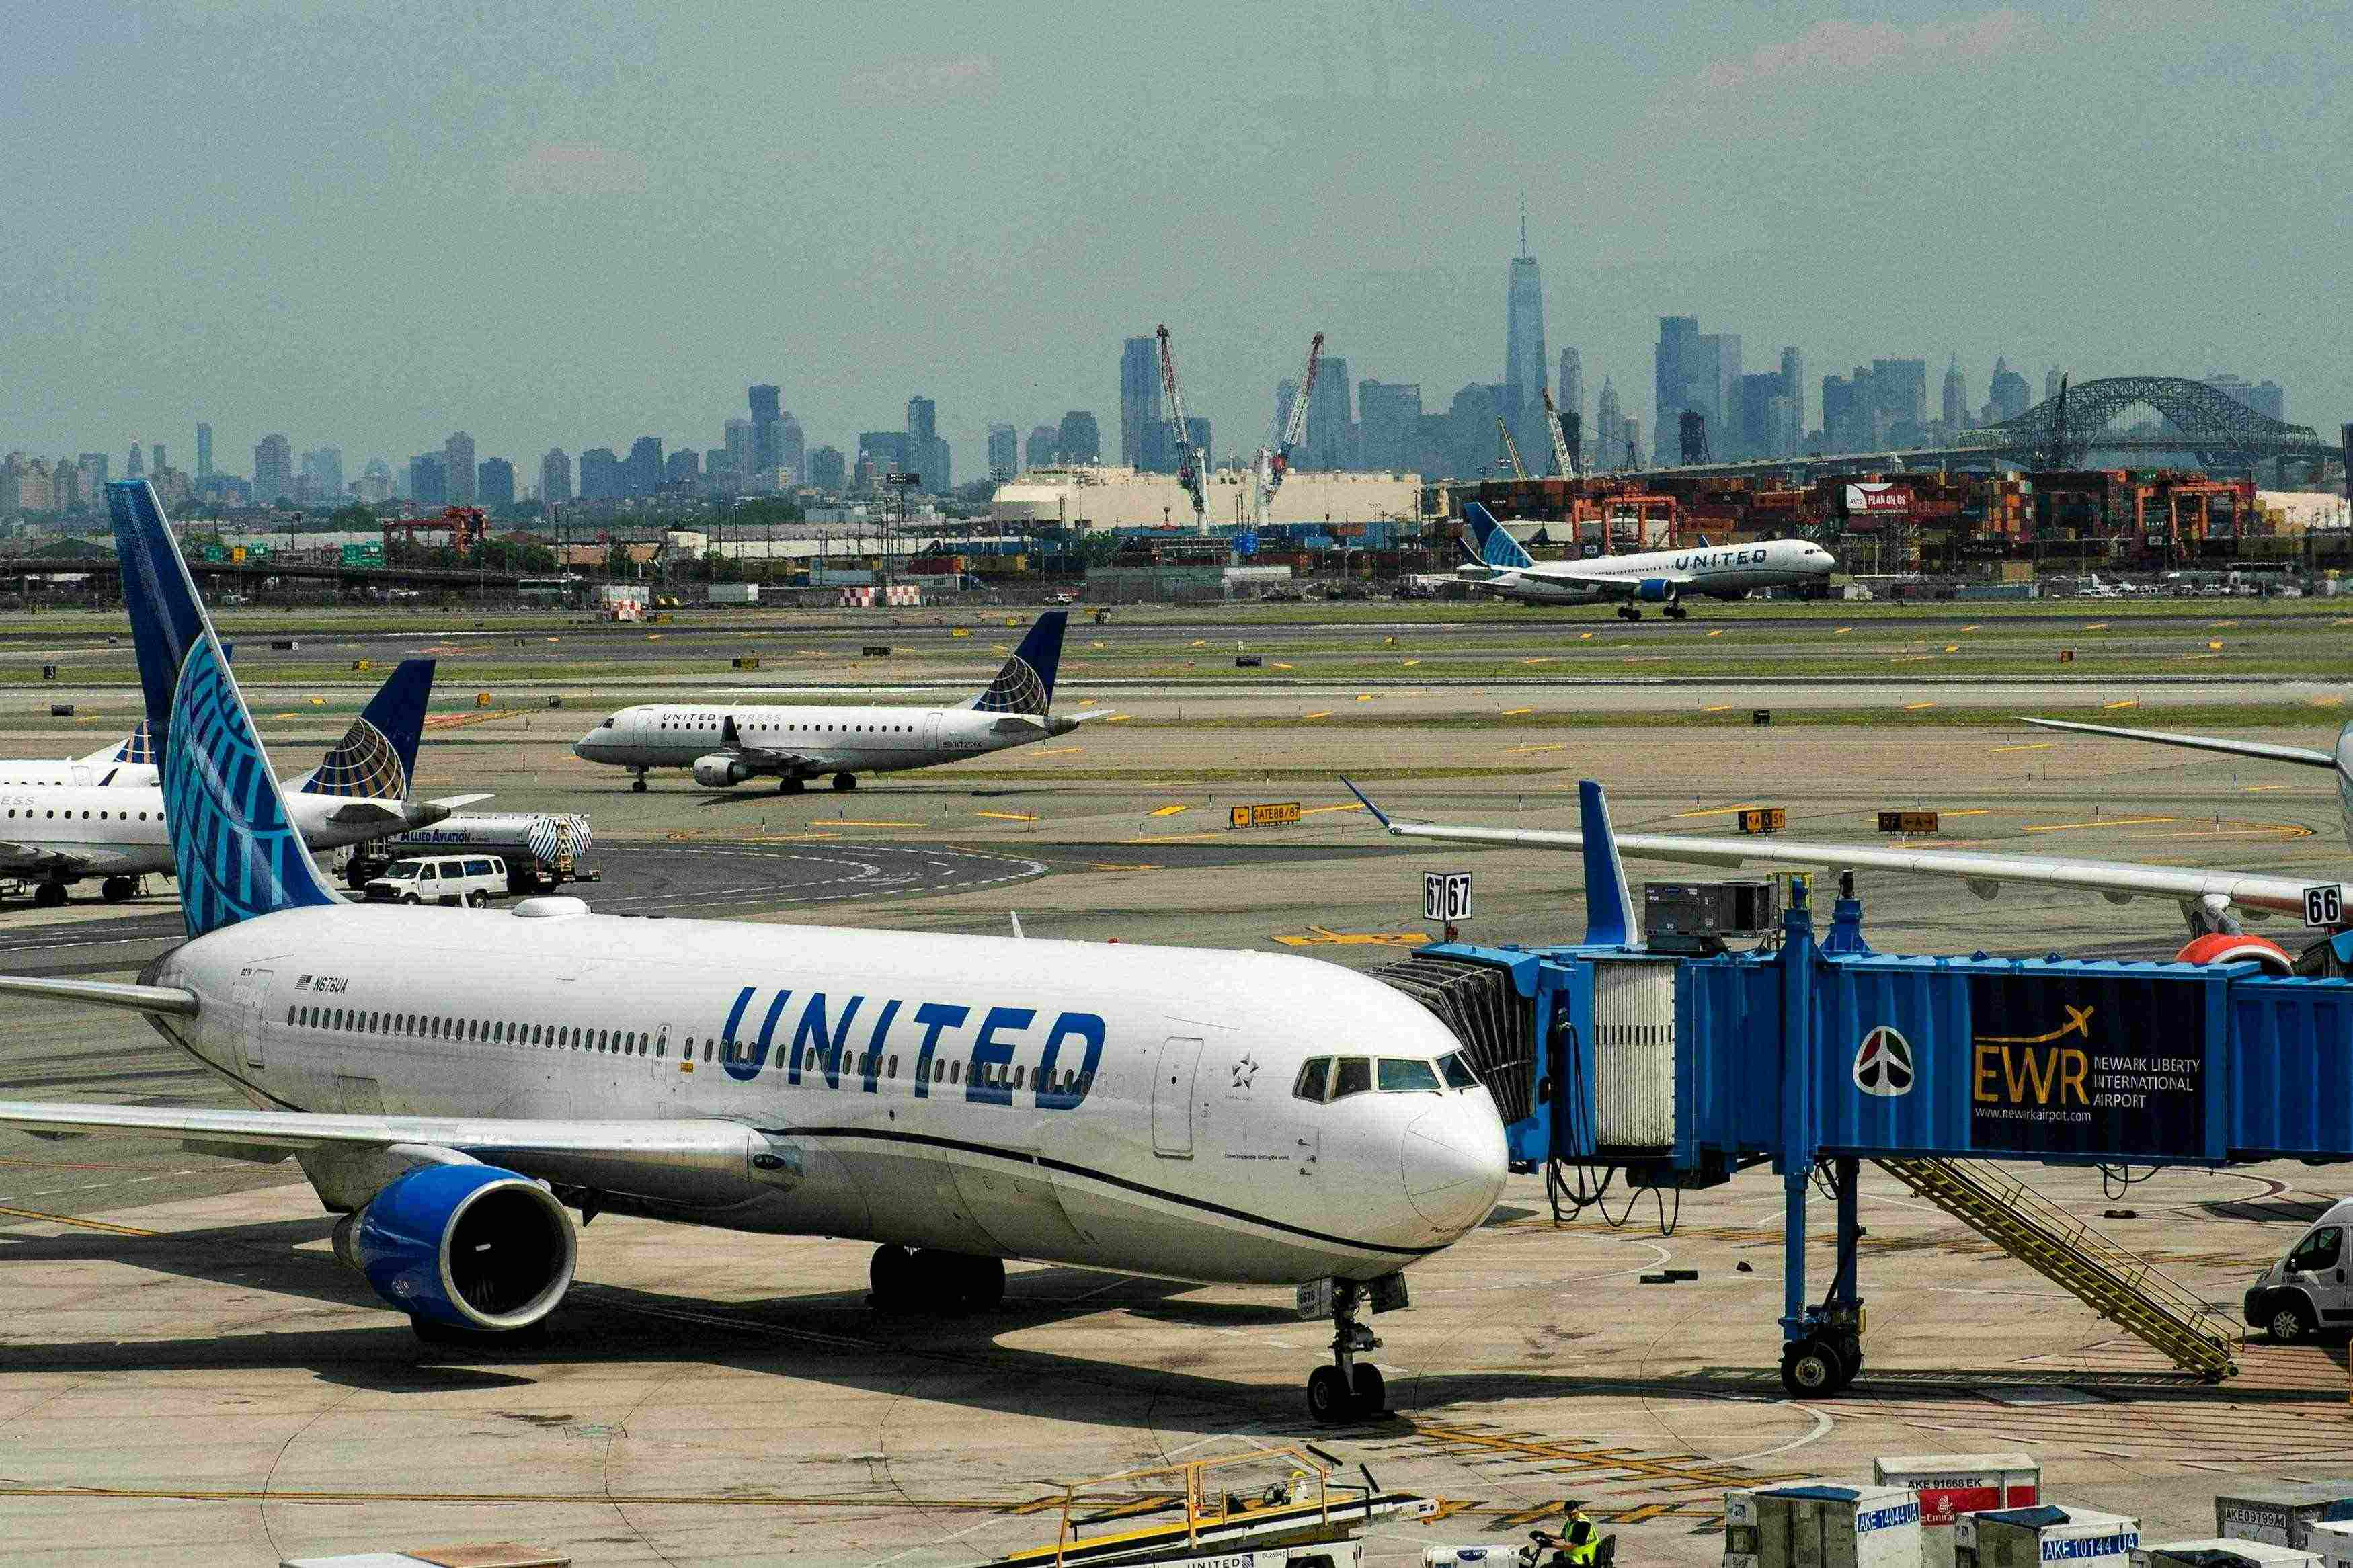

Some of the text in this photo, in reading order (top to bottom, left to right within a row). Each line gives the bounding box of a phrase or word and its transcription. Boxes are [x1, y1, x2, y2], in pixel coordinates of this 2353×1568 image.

[1868, 495, 1885, 505] PLAN
[1886, 495, 1895, 505] ON
[1674, 549, 1767, 570] UNITED
[663, 713, 716, 721] UNITED
[1426, 876, 1443, 917] 67
[1447, 877, 1470, 917] 67
[2308, 889, 2339, 923] 66
[313, 975, 349, 994] N676UA
[722, 986, 1107, 1110] UNITED
[1974, 1044, 2091, 1104] EWR
[2093, 1056, 2200, 1073] NEWARK LIBERTY
[2093, 1075, 2194, 1091] INTERNATIONAL
[2093, 1093, 2147, 1108] AIRPORT
[1908, 1478, 1983, 1489] AKE 91668 EK
[1860, 1503, 1919, 1532] AKE 14044 UA
[2045, 1533, 2136, 1560] AKE 10144 UA
[1187, 1559, 1240, 1568] UNITED
